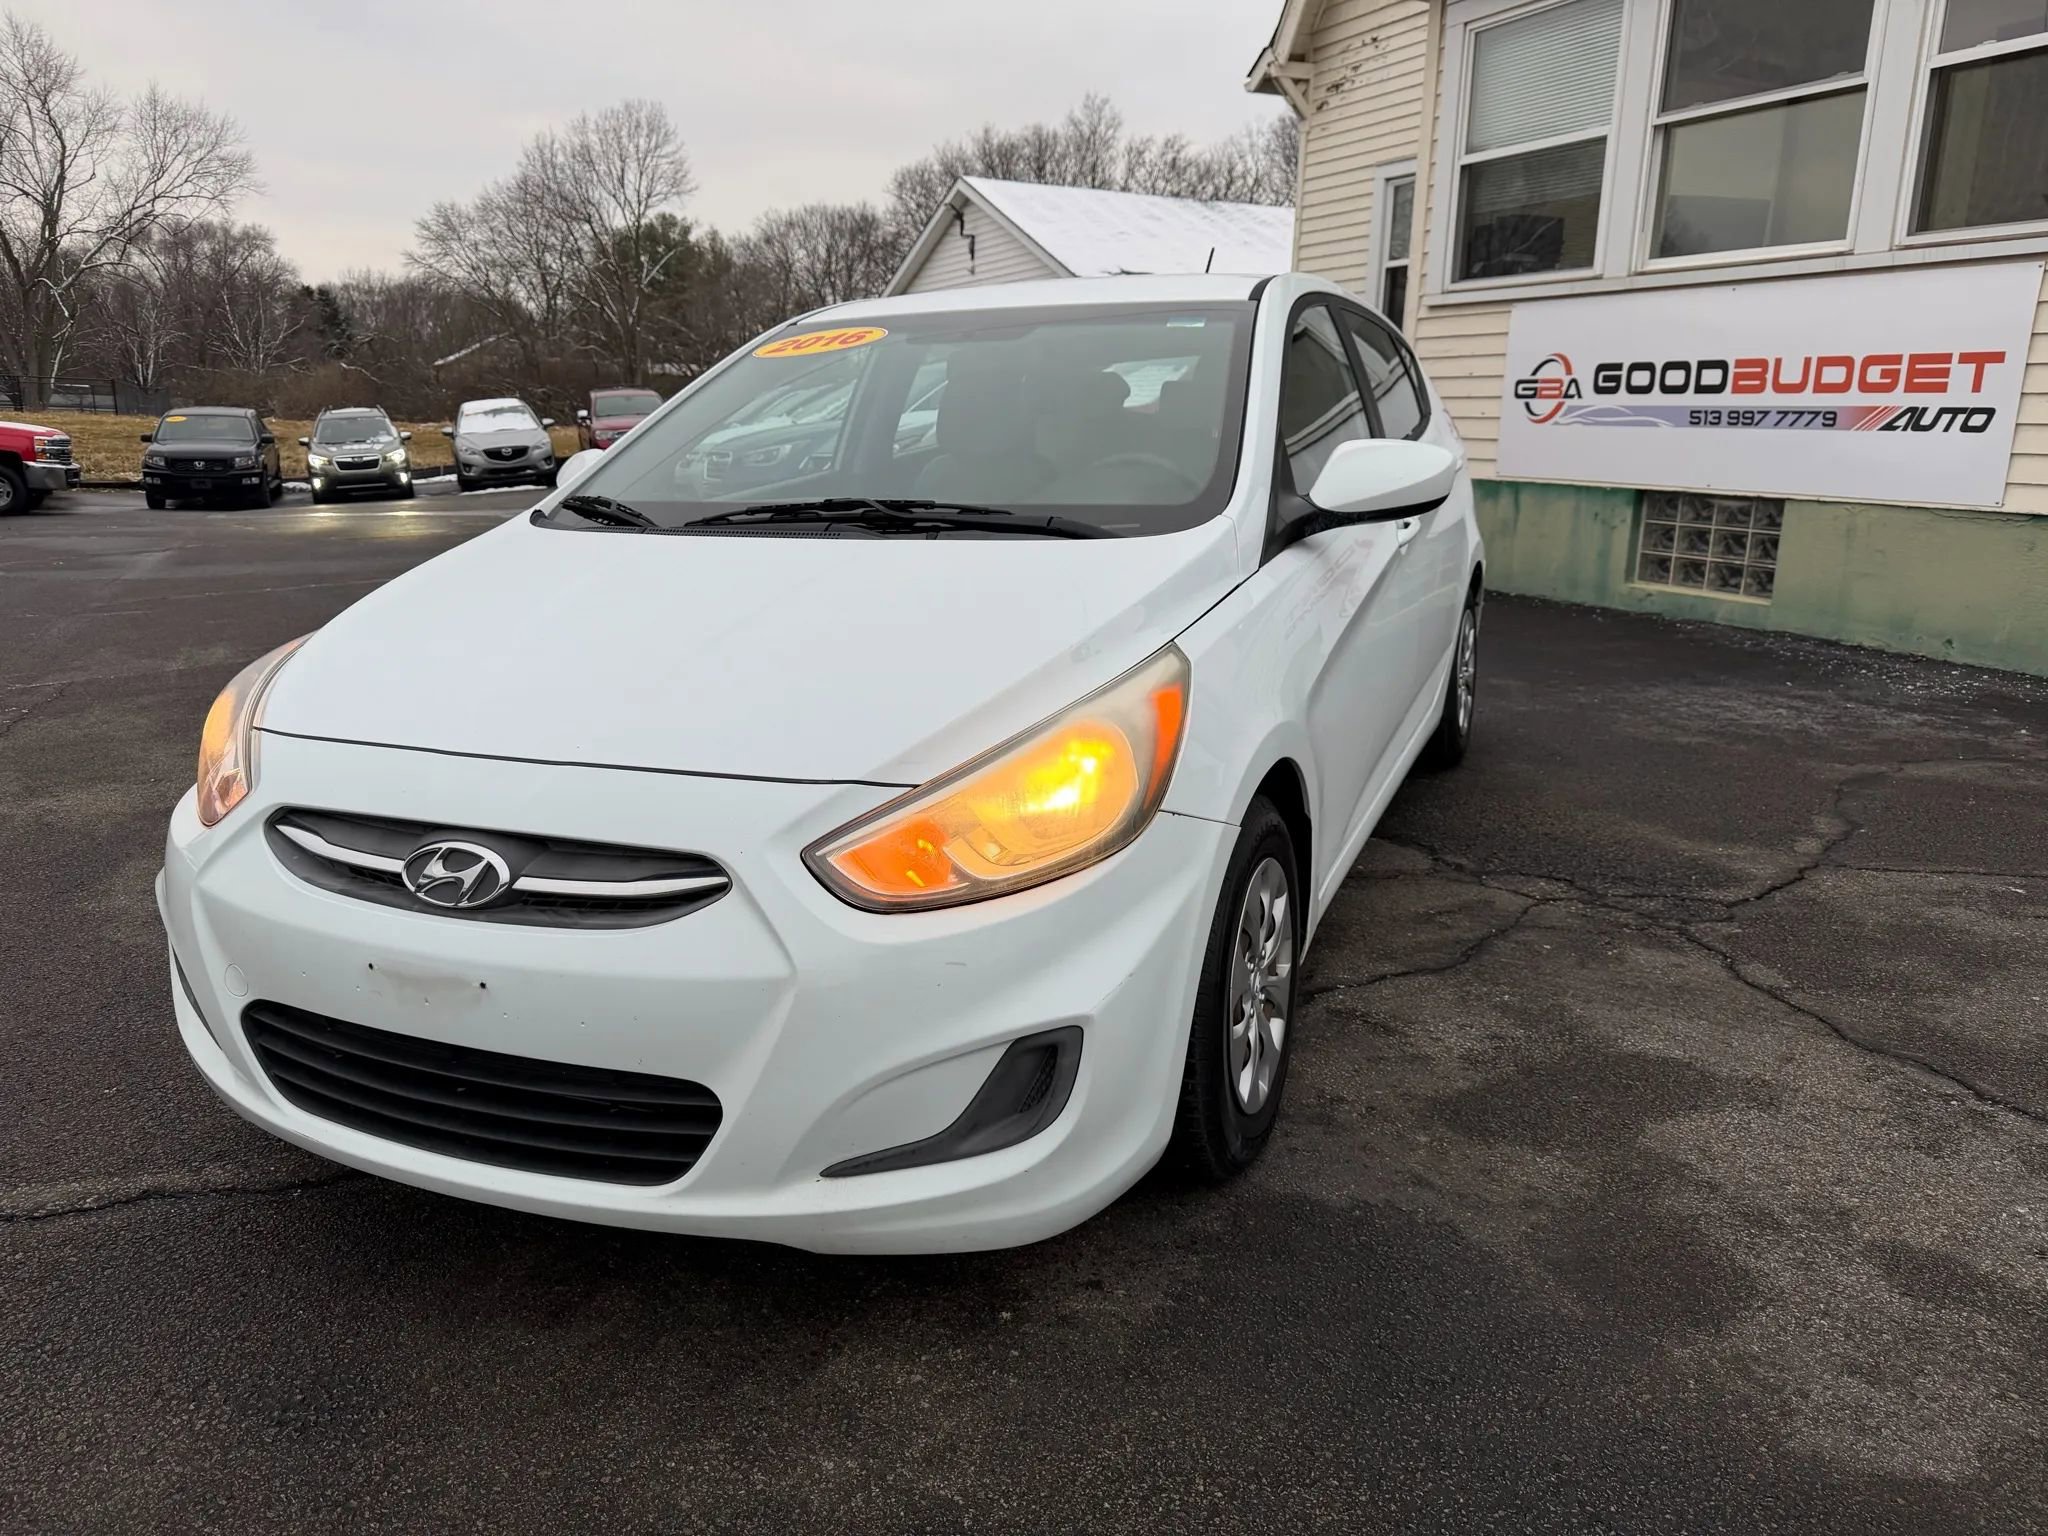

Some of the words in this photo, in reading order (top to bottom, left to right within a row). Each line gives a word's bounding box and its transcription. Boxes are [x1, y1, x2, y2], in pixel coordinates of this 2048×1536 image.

[763, 330, 873, 355] 2016
[1514, 378, 1583, 399] GBA
[1689, 410, 1722, 426] 513
[1727, 410, 1770, 427] 997
[1774, 410, 1838, 428] 7779
[1878, 406, 1996, 433] AUTO
